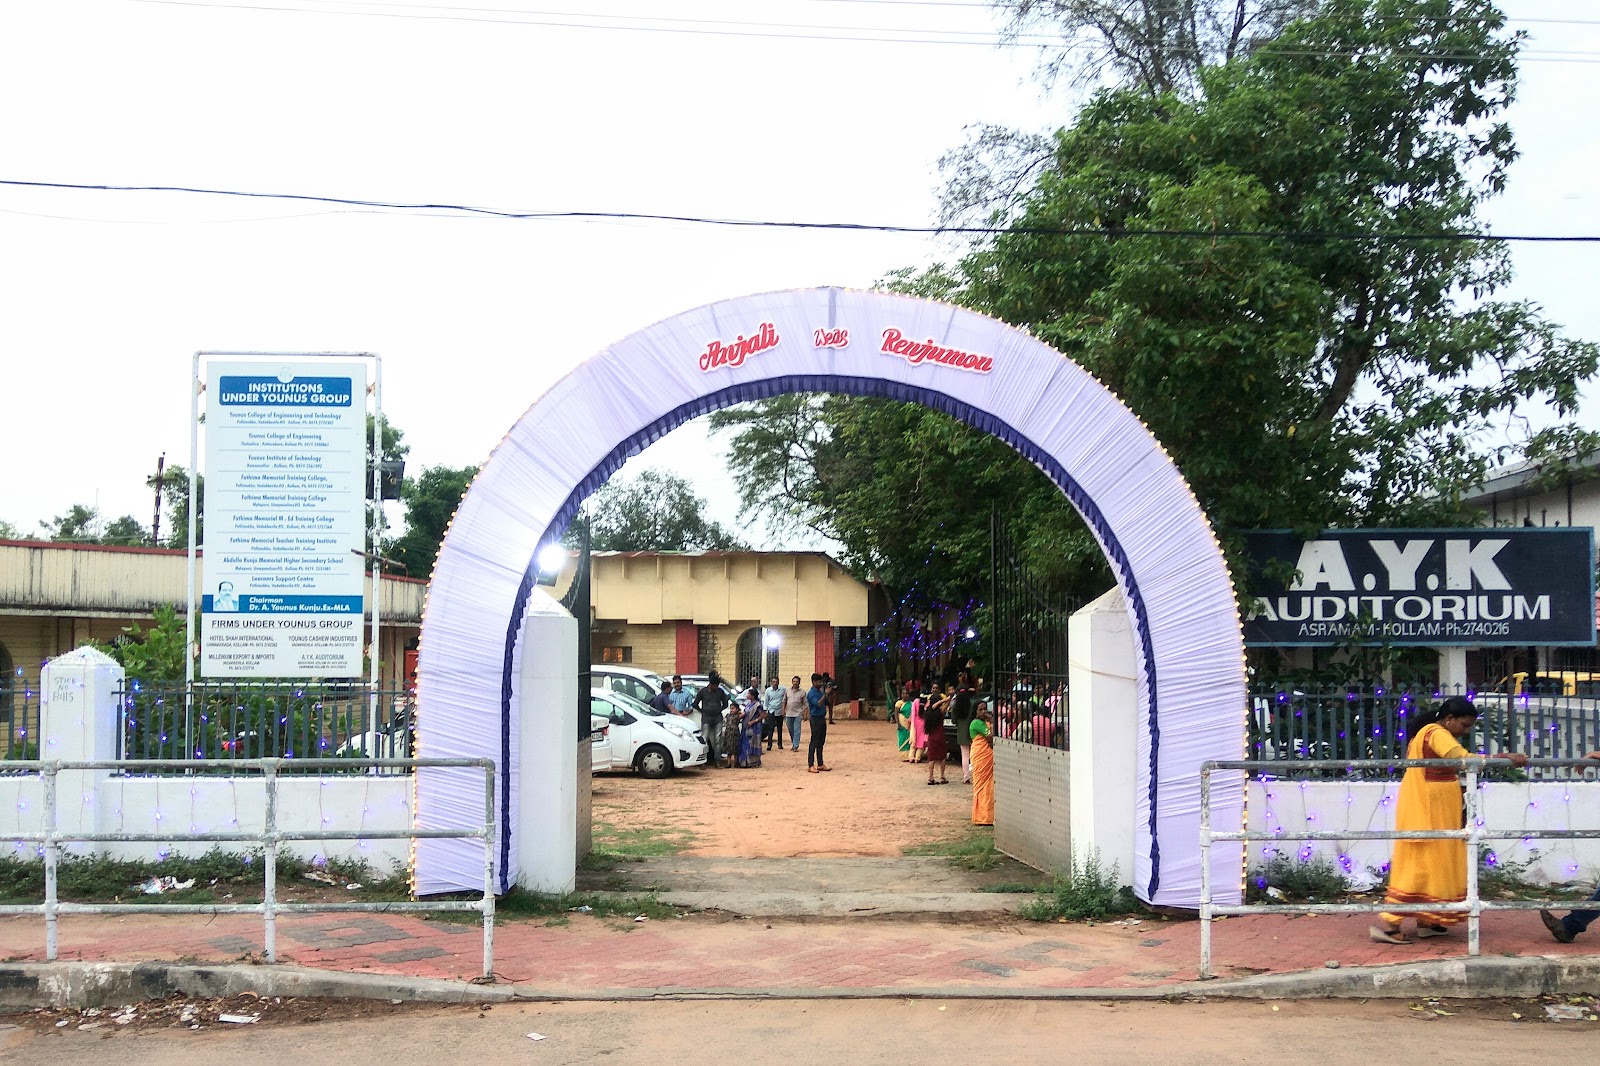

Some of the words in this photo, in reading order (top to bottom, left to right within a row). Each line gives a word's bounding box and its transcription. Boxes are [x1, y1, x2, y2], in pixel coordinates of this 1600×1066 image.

[814, 328, 848, 348] Weds
[699, 322, 780, 371] Anjali
[881, 328, 993, 372] Renjumon
[248, 383, 323, 393] INSTITUTIONS
[222, 393, 260, 403] UNDER
[262, 393, 308, 403] YOUNUS
[310, 394, 350, 404] GROUP
[274, 412, 303, 420] Engineering
[266, 432, 286, 440] College
[1289, 540, 1513, 591] A.Y.K
[1245, 596, 1551, 621] AUDITORIUM
[212, 620, 240, 628] FIRMS
[242, 620, 274, 628] UNDER
[278, 620, 316, 628] YOUNUS
[320, 620, 352, 628] GROUP
